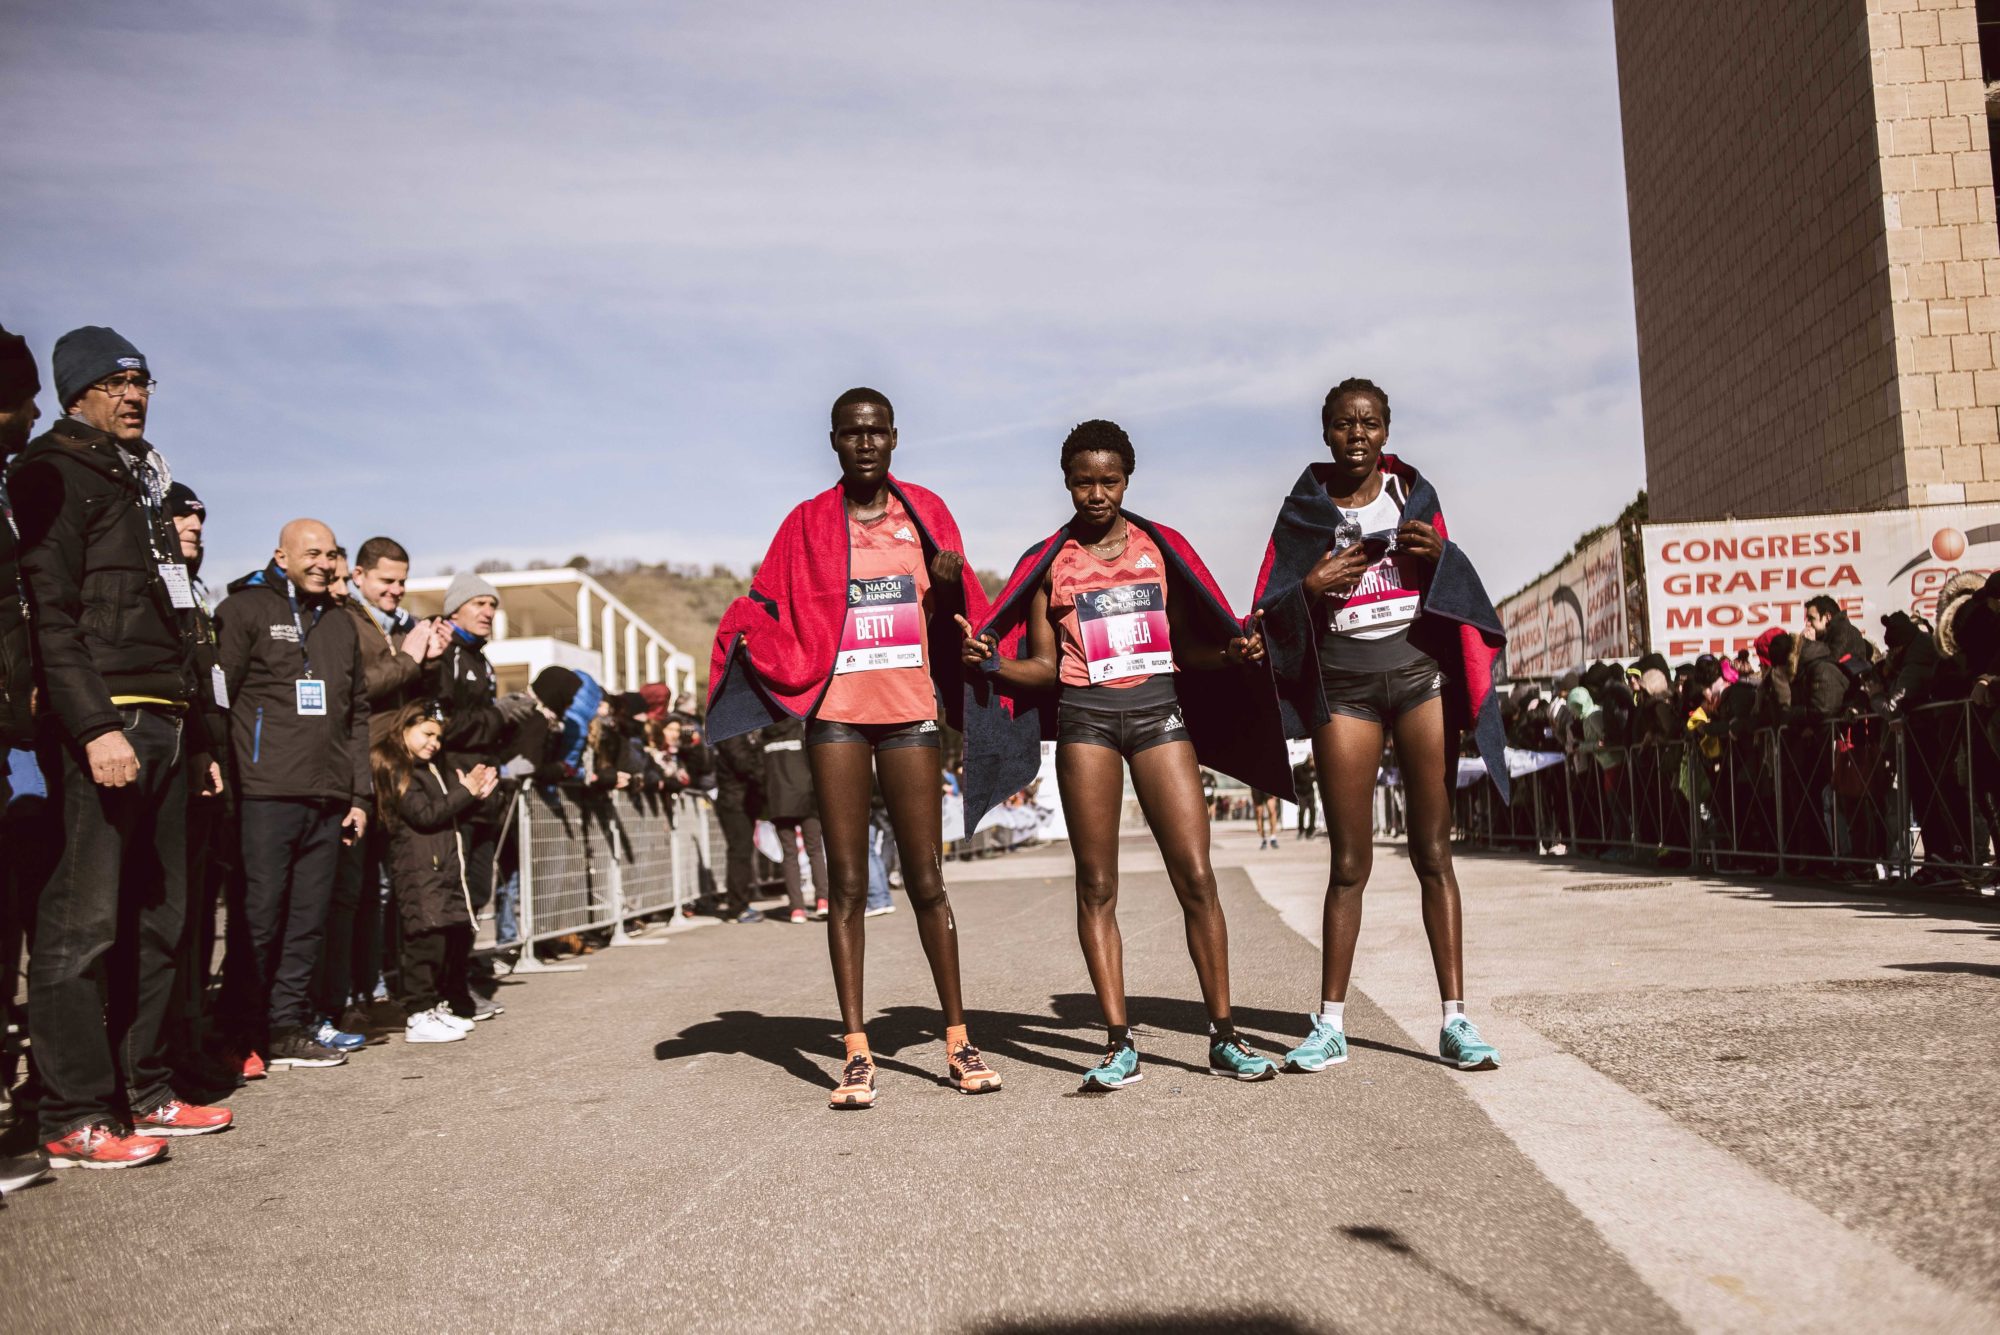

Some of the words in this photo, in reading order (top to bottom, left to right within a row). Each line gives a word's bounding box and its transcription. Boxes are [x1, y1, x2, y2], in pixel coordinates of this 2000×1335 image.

[1661, 529, 1861, 563] CONGRESSI
[865, 581, 901, 592] NAPOLI
[1663, 563, 1863, 596] GRAFICA
[866, 591, 902, 601] RUNNING
[1116, 588, 1150, 600] NAPOLI
[1118, 599, 1151, 609] RUNNING
[1666, 597, 1864, 630] MOSTE
[855, 614, 894, 640] BETTY
